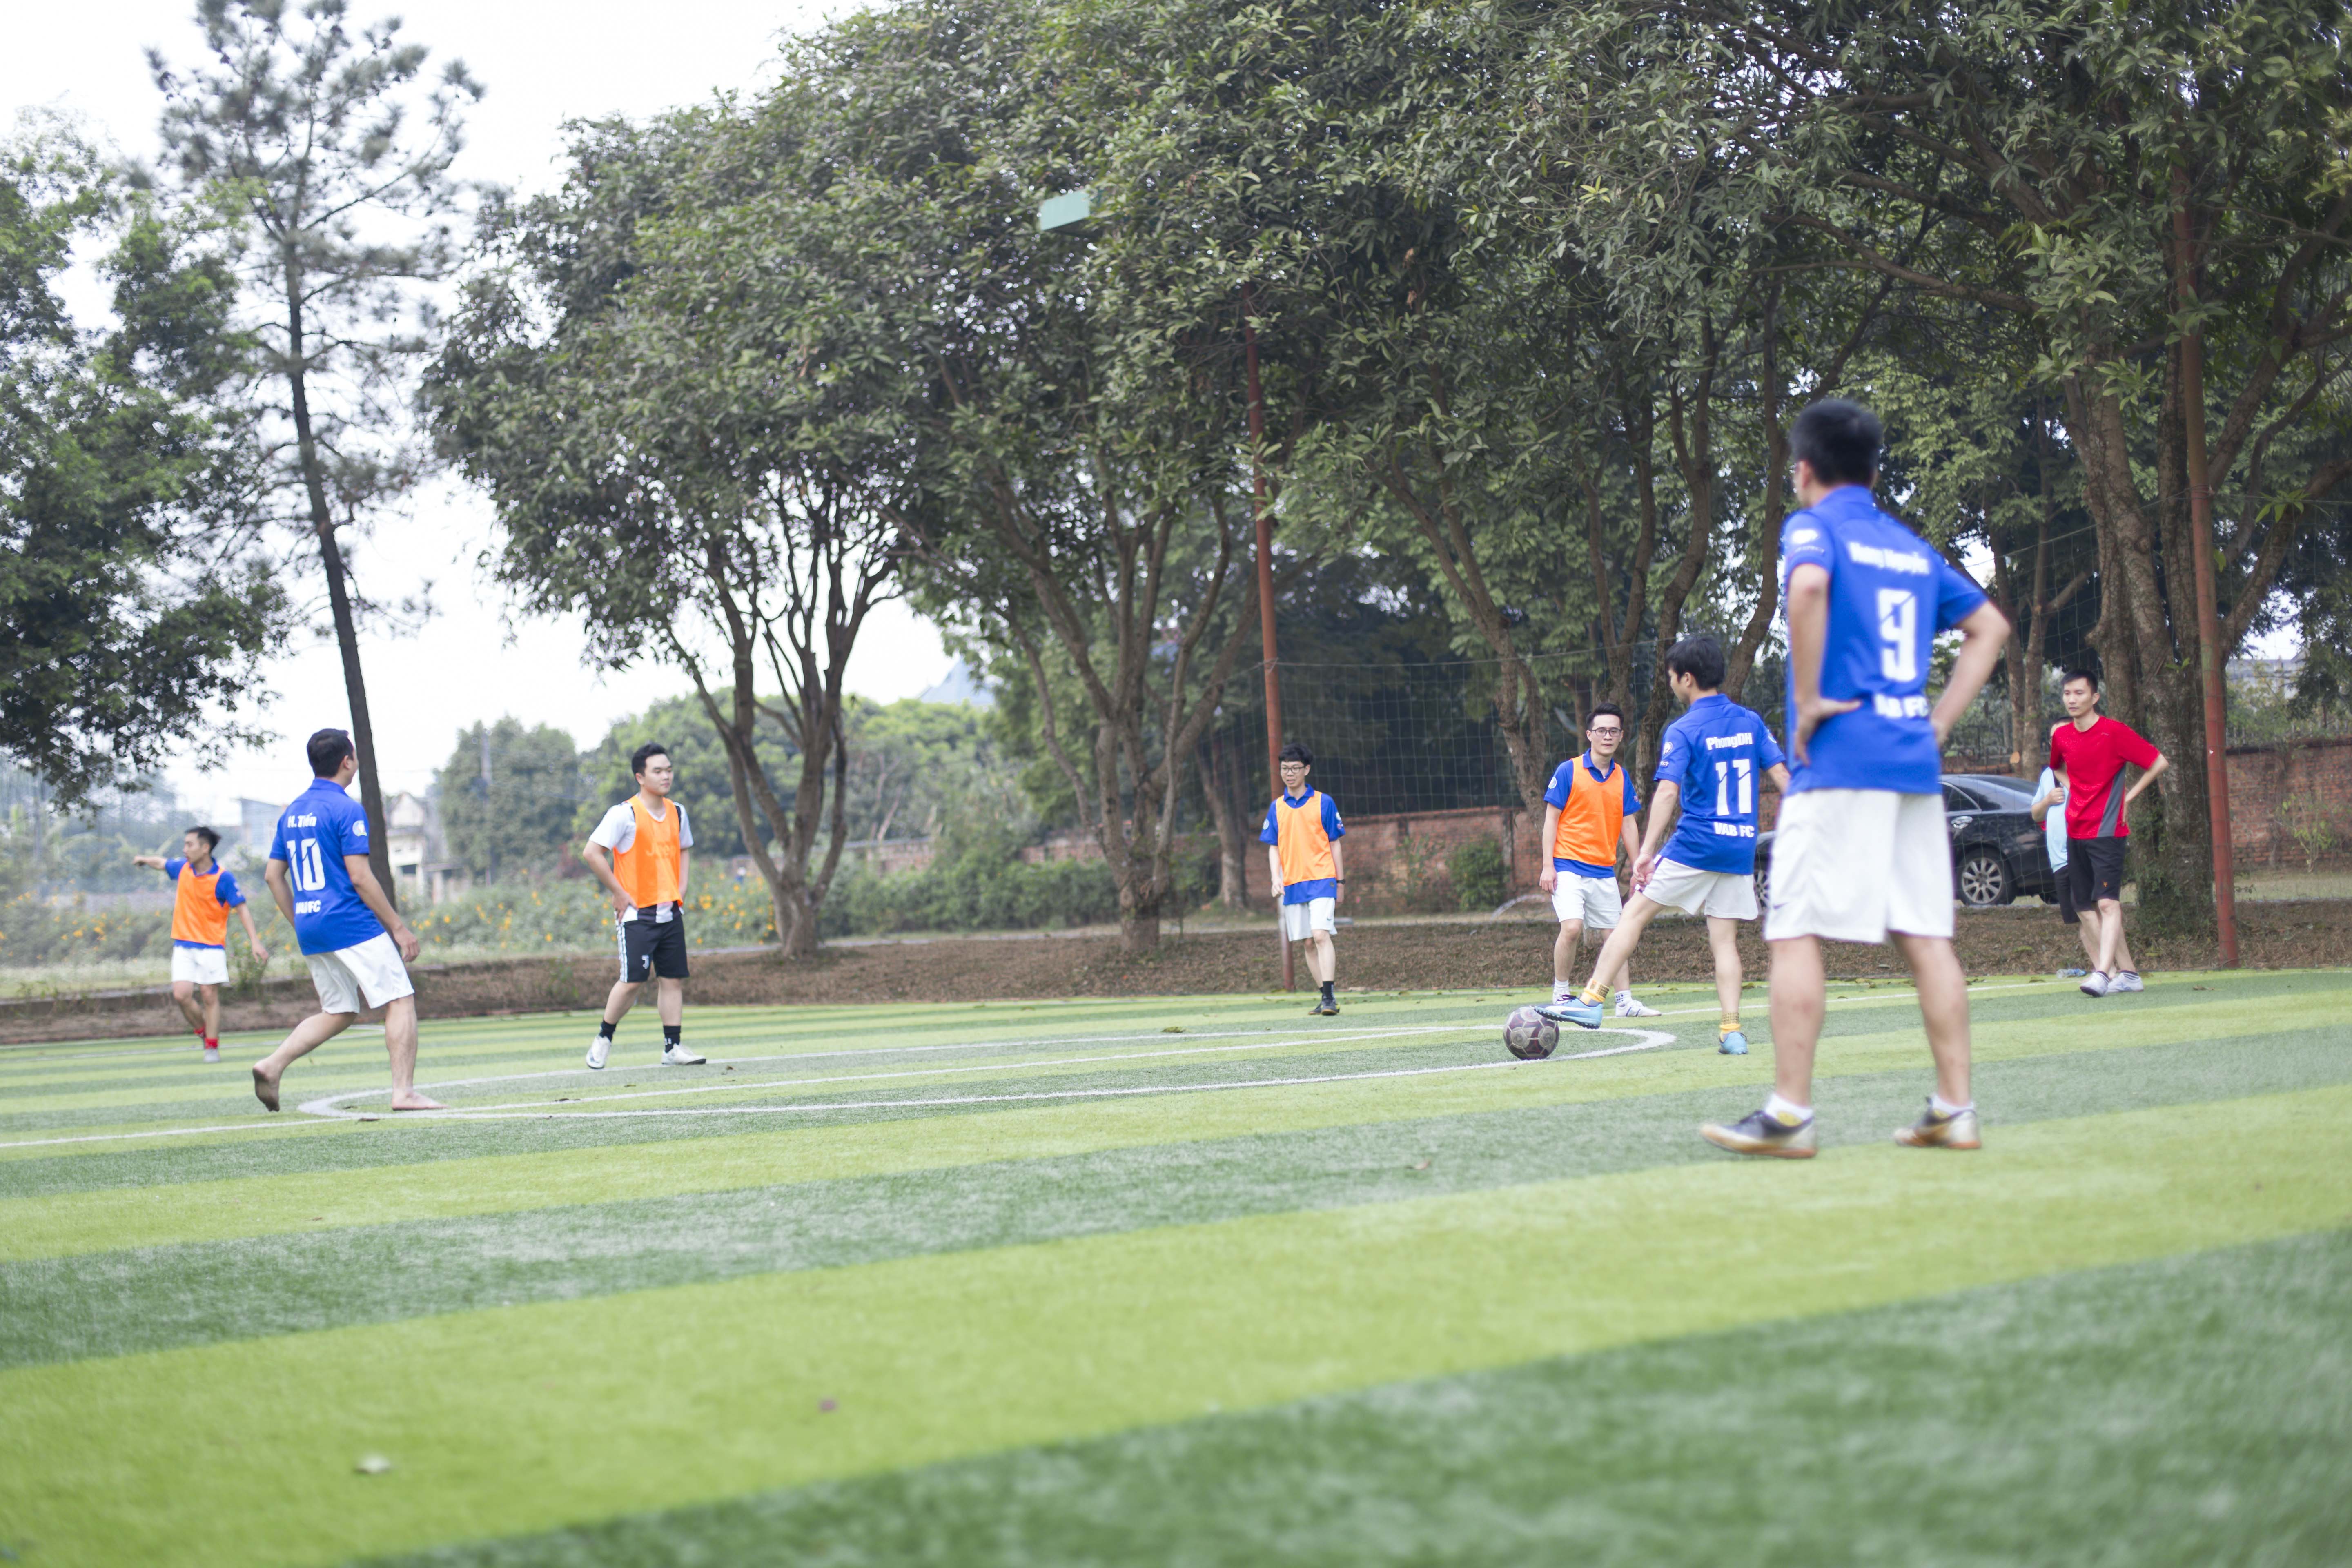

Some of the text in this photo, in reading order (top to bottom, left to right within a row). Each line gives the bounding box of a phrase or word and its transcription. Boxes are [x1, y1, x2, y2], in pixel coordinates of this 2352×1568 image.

[1877, 589, 1917, 682] 9
[1905, 696, 1929, 718] FC
[1715, 759, 1751, 816] 11
[1714, 822, 1755, 838] VAB FC
[287, 838, 325, 891] 10
